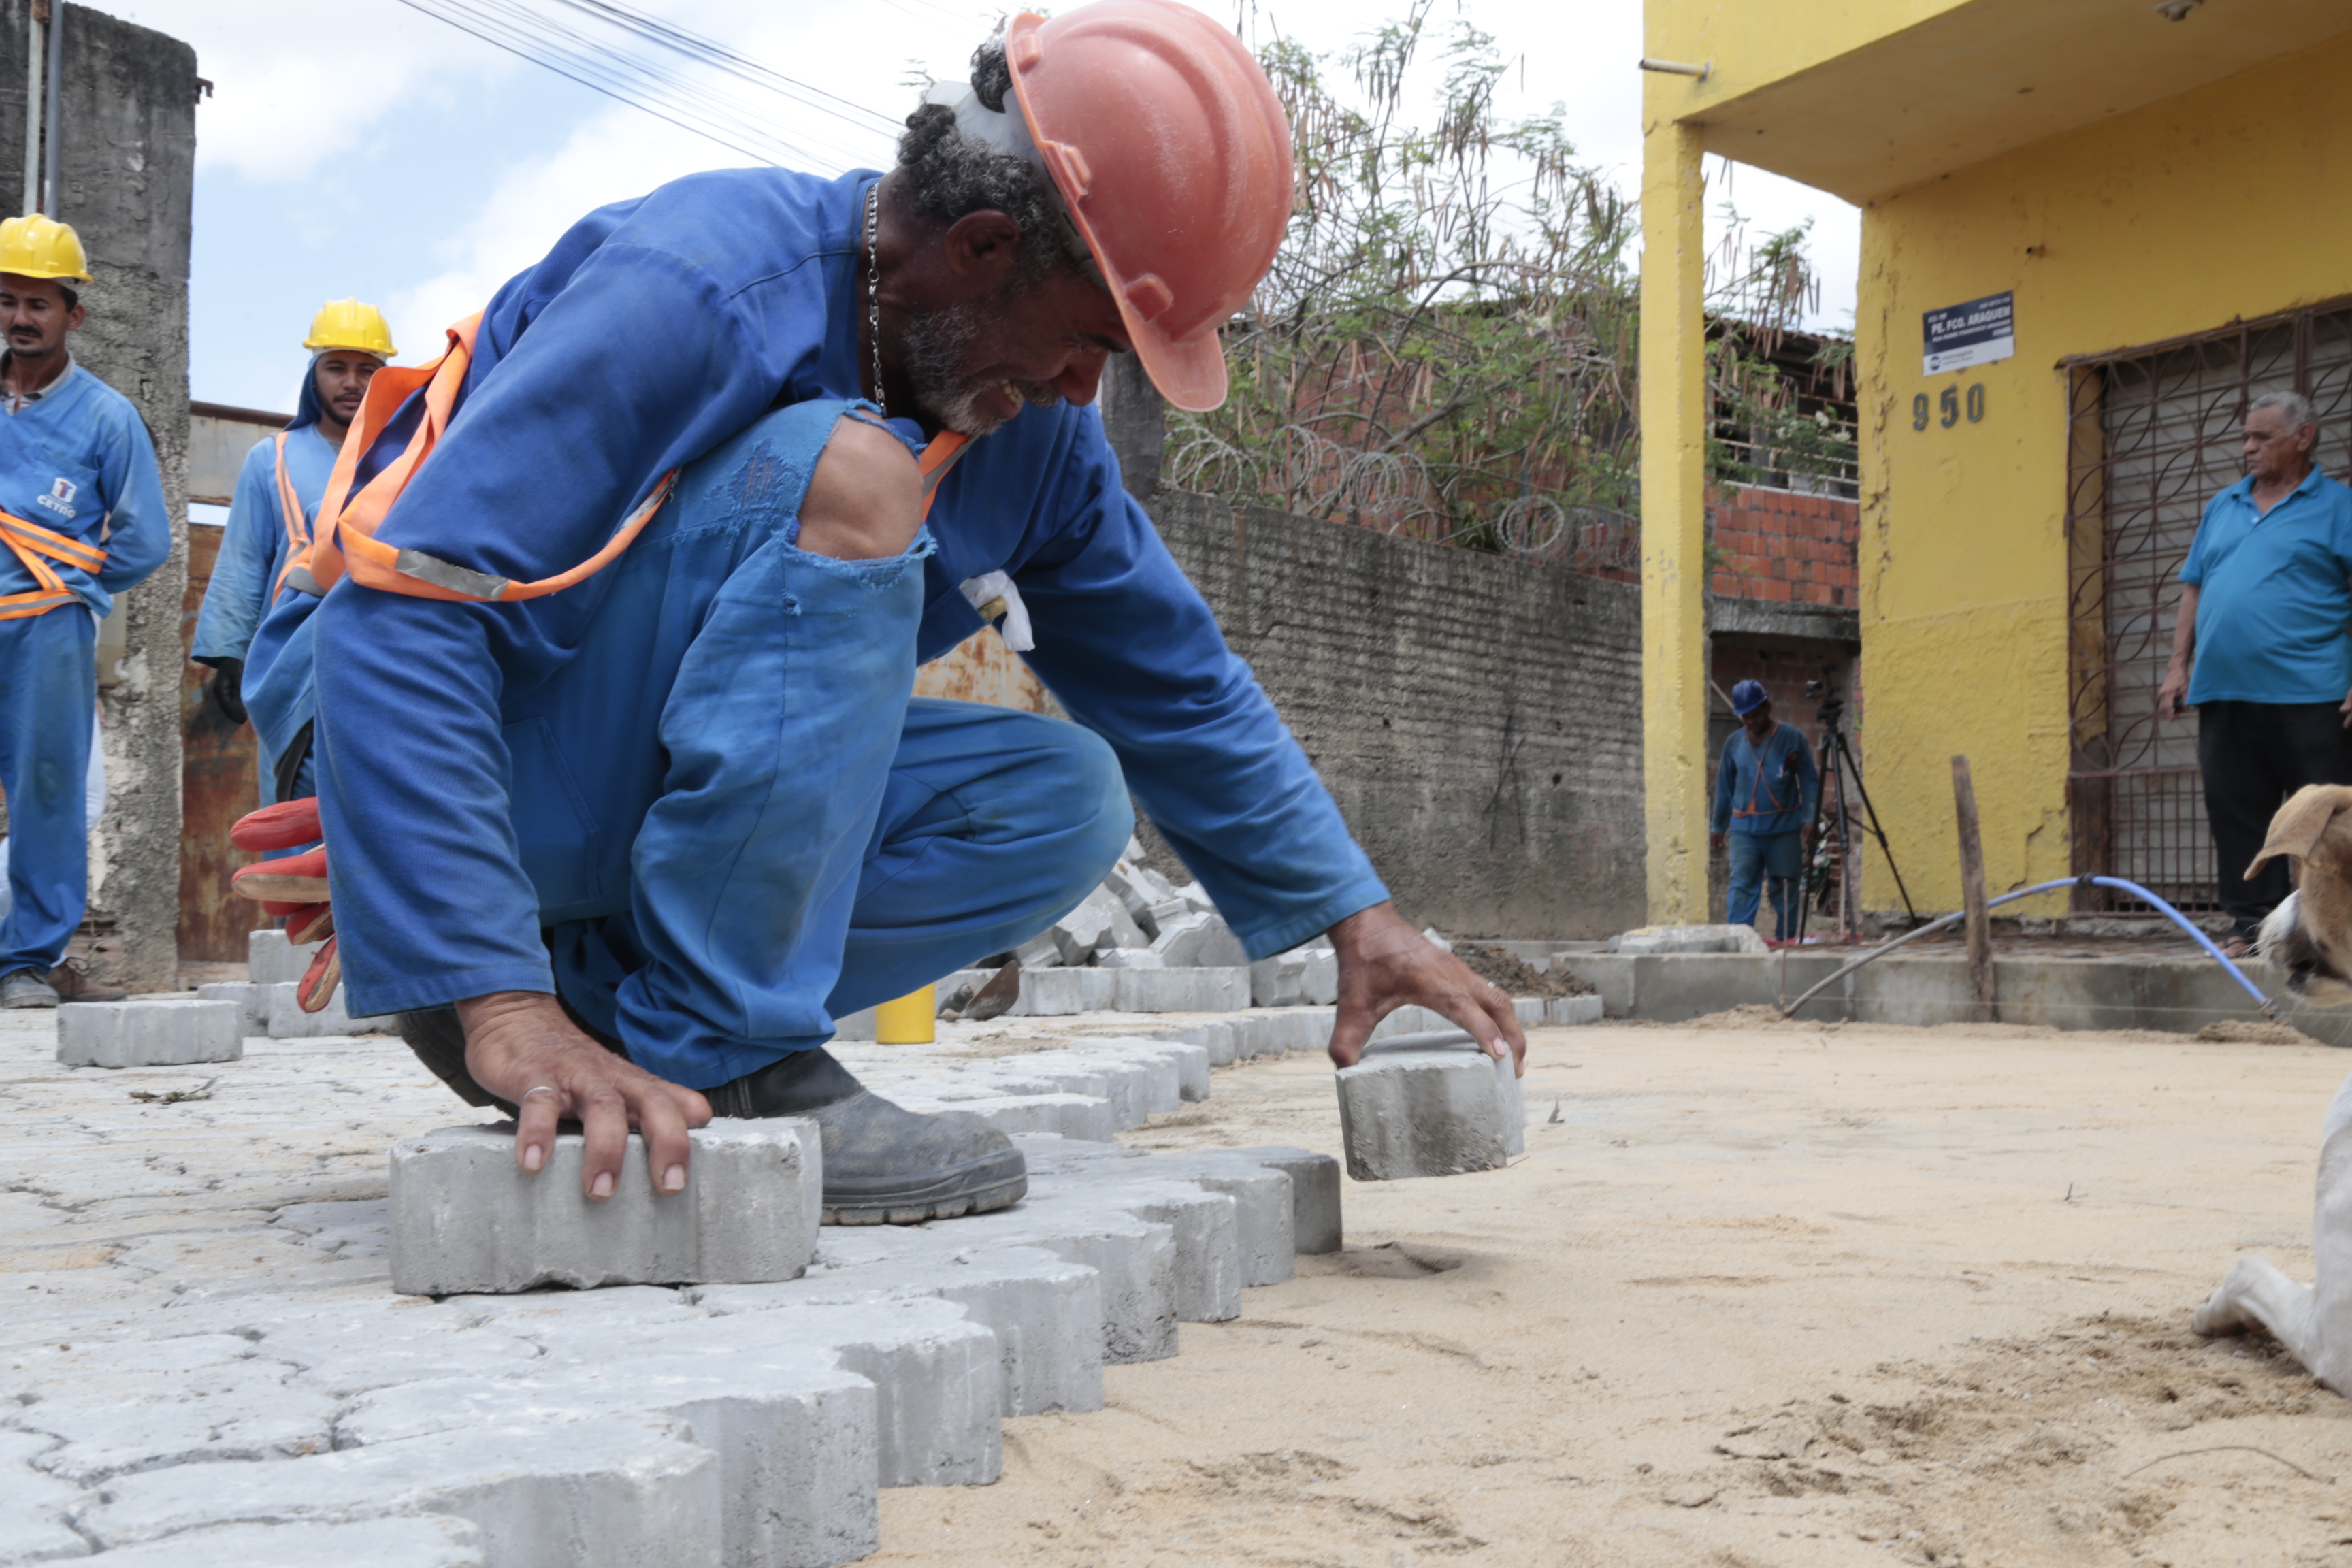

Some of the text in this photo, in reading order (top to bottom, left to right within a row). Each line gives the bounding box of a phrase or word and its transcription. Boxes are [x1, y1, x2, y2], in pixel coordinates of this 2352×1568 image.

[1931, 322, 1946, 336] PE.
[1946, 316, 1967, 331] FCO.
[1967, 305, 2011, 326] ARAQUEM
[1913, 383, 1984, 431] 950
